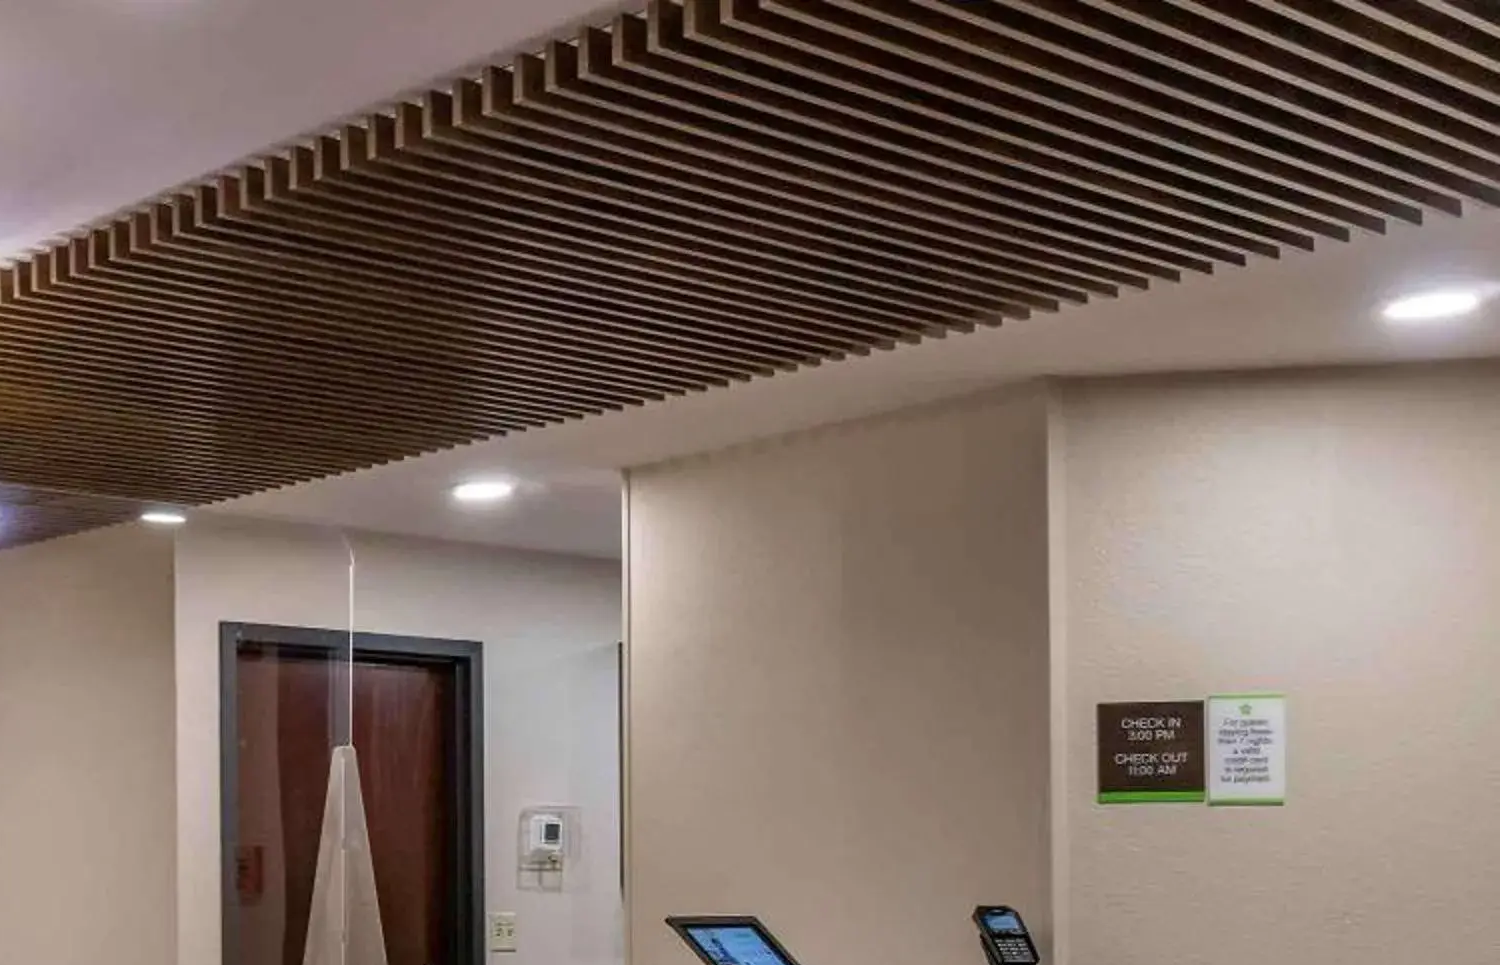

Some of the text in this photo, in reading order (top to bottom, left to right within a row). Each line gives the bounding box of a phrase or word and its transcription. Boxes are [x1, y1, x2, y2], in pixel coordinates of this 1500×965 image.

[1120, 717, 1182, 729] CHECK IN
[1127, 729, 1176, 741] 3:00 PM
[1115, 752, 1189, 765] CHECK OUT
[1129, 765, 1178, 776] 11:00 AM
